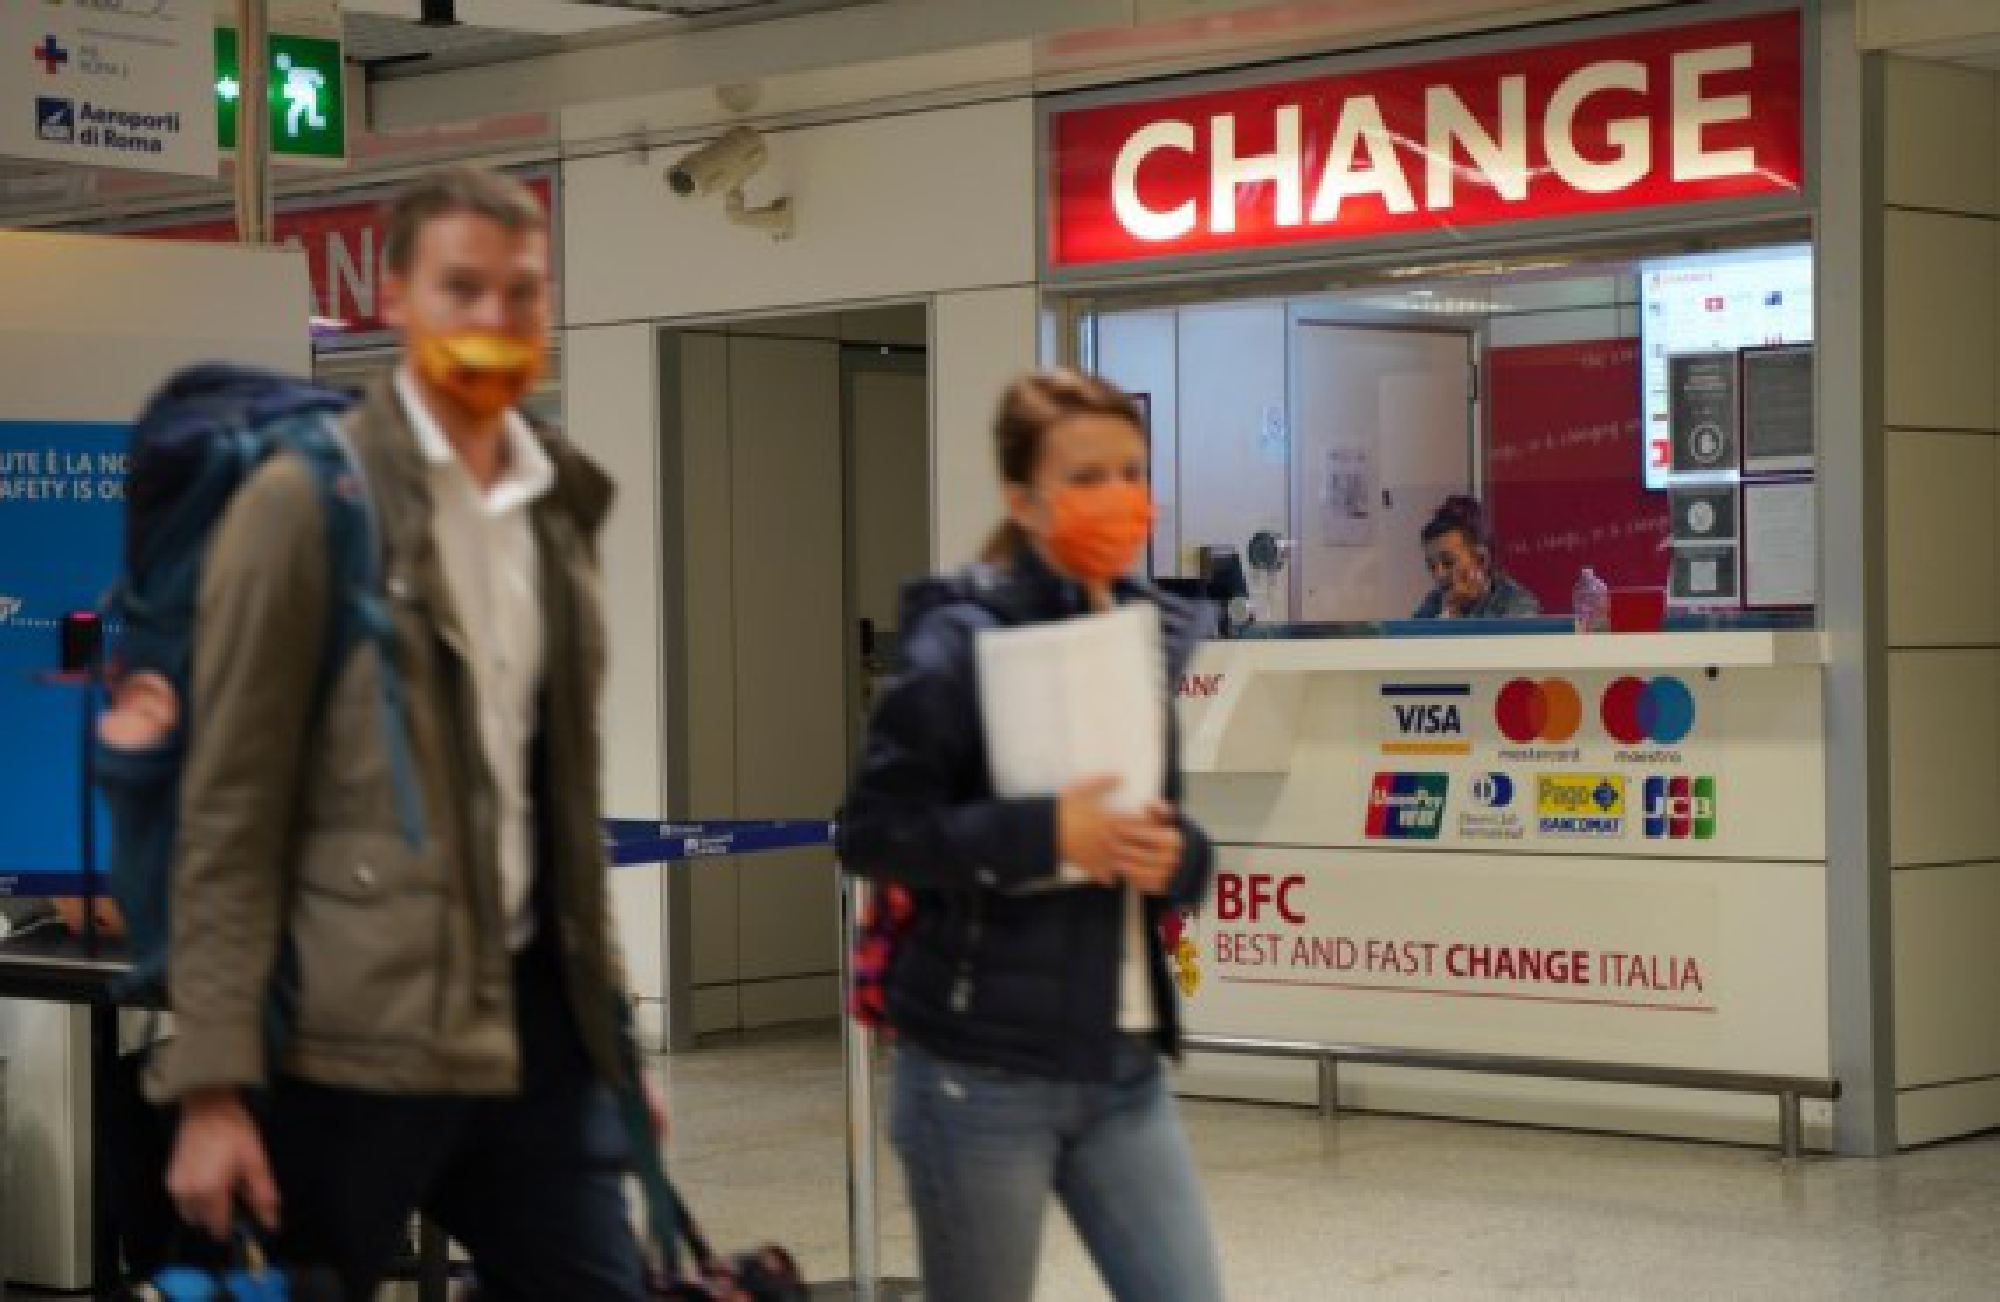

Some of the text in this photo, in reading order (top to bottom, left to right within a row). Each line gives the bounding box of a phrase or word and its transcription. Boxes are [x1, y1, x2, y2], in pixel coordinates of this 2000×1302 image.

[80, 102, 180, 132] Aeroporti
[80, 128, 162, 153] di Roma
[1111, 42, 1754, 241] CHANGE
[66, 452, 92, 475] LA
[73, 479, 92, 499] IS
[1393, 704, 1461, 734] VISA
[1539, 776, 1591, 812] Pago
[1539, 817, 1622, 835] BANCOMAT
[1216, 873, 1306, 925] BFC
[1215, 932, 1703, 994] BEST AND FAST CHANGE ITALIA
